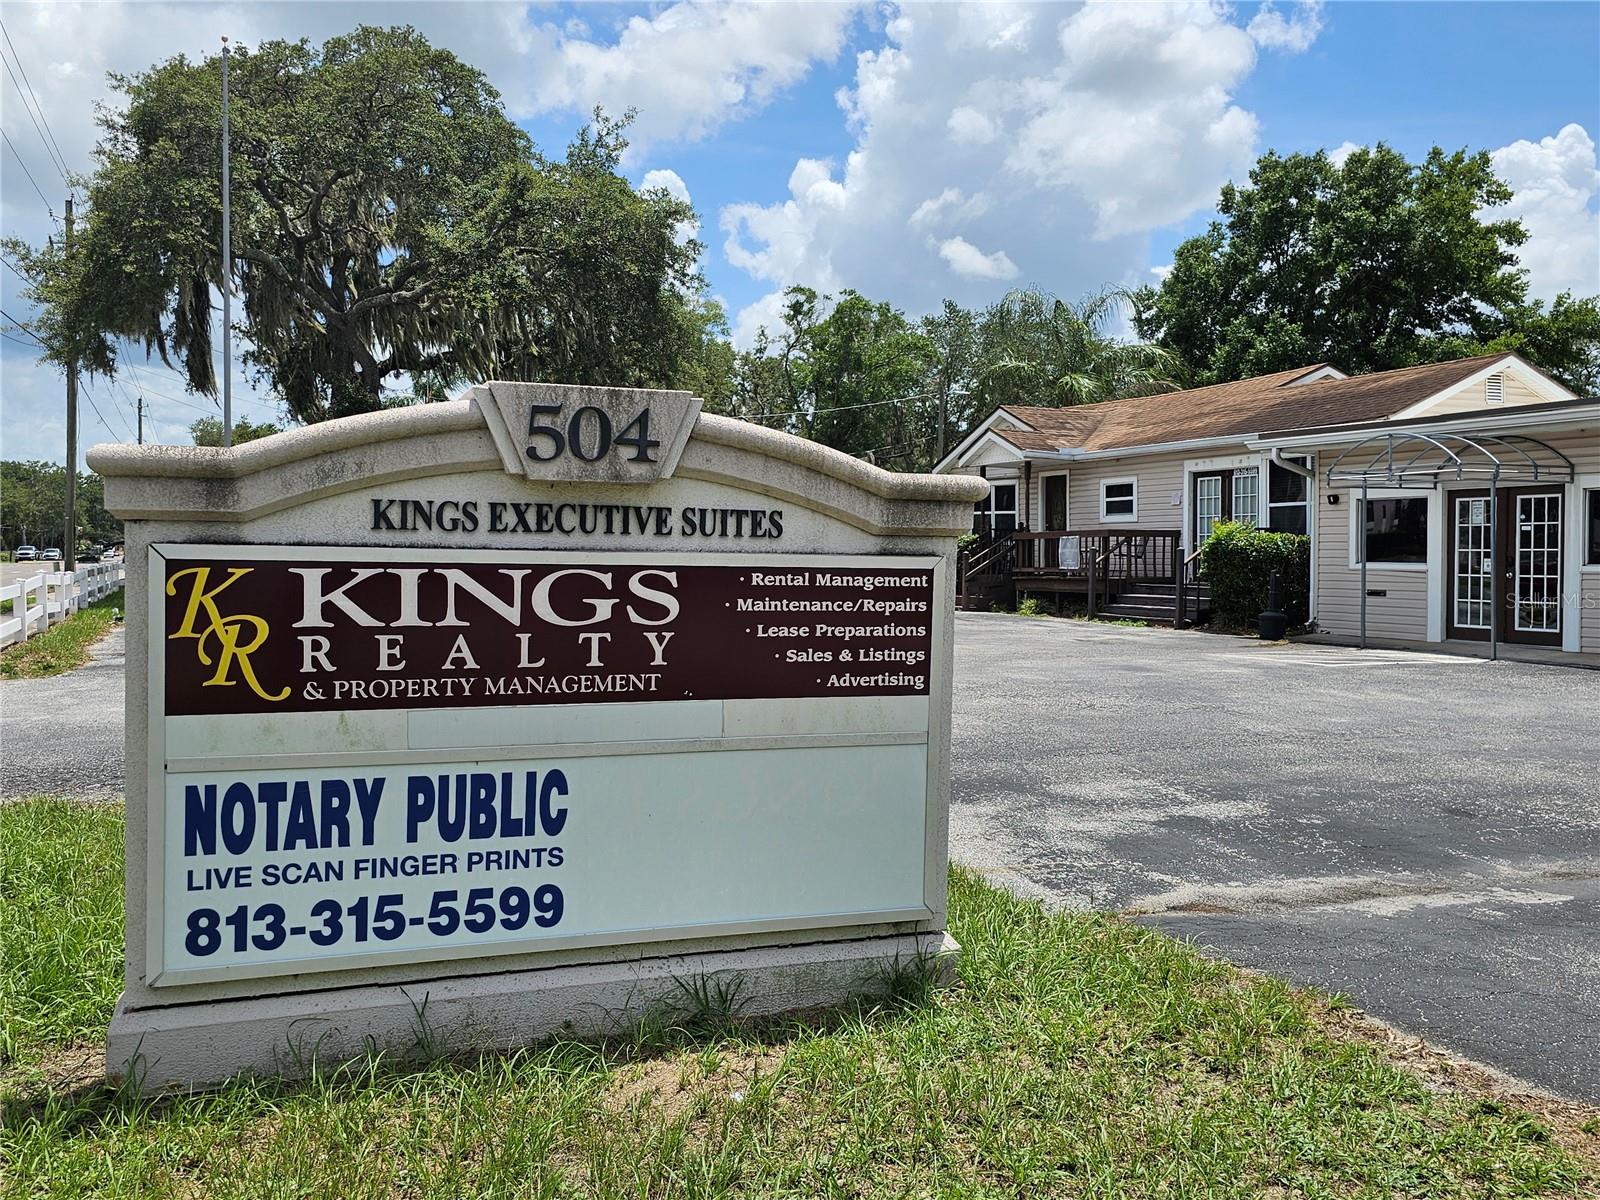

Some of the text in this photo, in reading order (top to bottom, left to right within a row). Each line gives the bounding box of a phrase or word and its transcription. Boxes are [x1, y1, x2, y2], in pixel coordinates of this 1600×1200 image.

[526, 403, 660, 464] 504
[371, 499, 783, 539] KINGS EXECUTIVE SUITES
[288, 567, 680, 628] KINGS
[752, 573, 928, 590] Rental Management
[737, 597, 926, 615] Maintenance/Repairs
[757, 623, 926, 640] Lease Preparations
[298, 632, 674, 673] REALTY
[786, 648, 925, 664] Sales & Listings
[304, 674, 661, 700] & PROPERTY MANAGEMENT
[827, 672, 924, 689] Advertising
[184, 769, 568, 856] NOTARY PUBLIC
[187, 847, 563, 891] LIVE SCAN FINGER PRINTS
[185, 883, 565, 957] 813-315-5599
